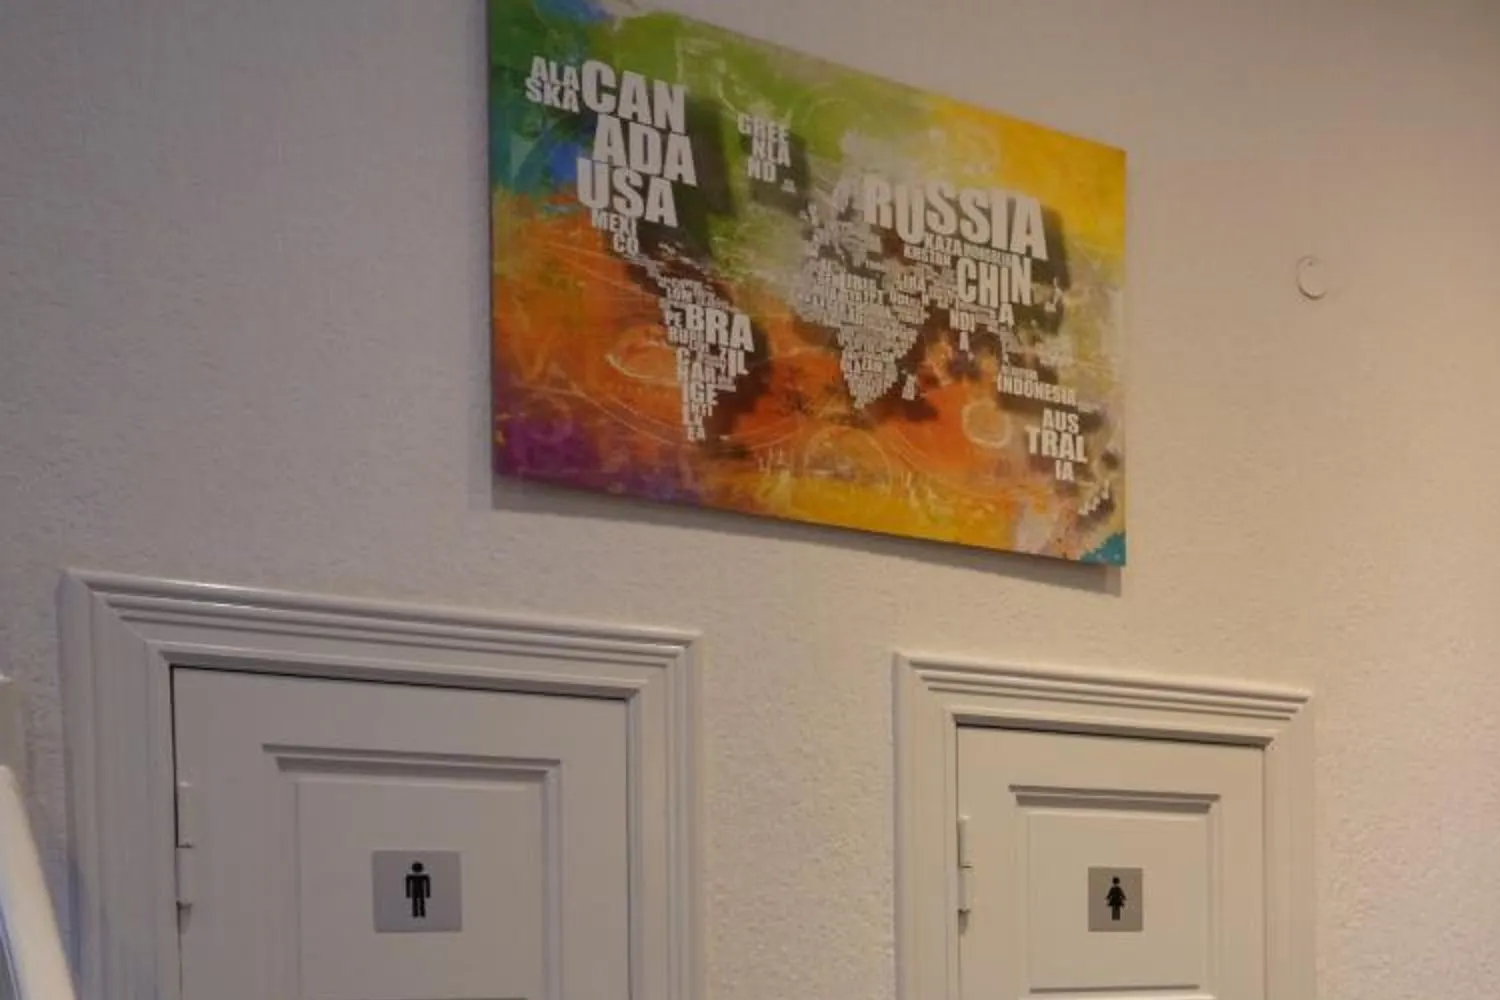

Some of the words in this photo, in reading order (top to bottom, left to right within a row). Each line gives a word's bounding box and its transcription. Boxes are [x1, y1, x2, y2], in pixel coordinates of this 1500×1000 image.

[524, 76, 580, 113] SKA
[530, 55, 579, 91] ALA
[581, 59, 685, 133] CAN
[592, 113, 698, 187] ADA
[576, 157, 678, 228] USA
[861, 175, 1049, 261] RUSSIA
[957, 254, 1031, 307] CHIN
[685, 303, 755, 353] BRA
[1024, 424, 1088, 464] TRAL
[1042, 407, 1080, 434] AUS
